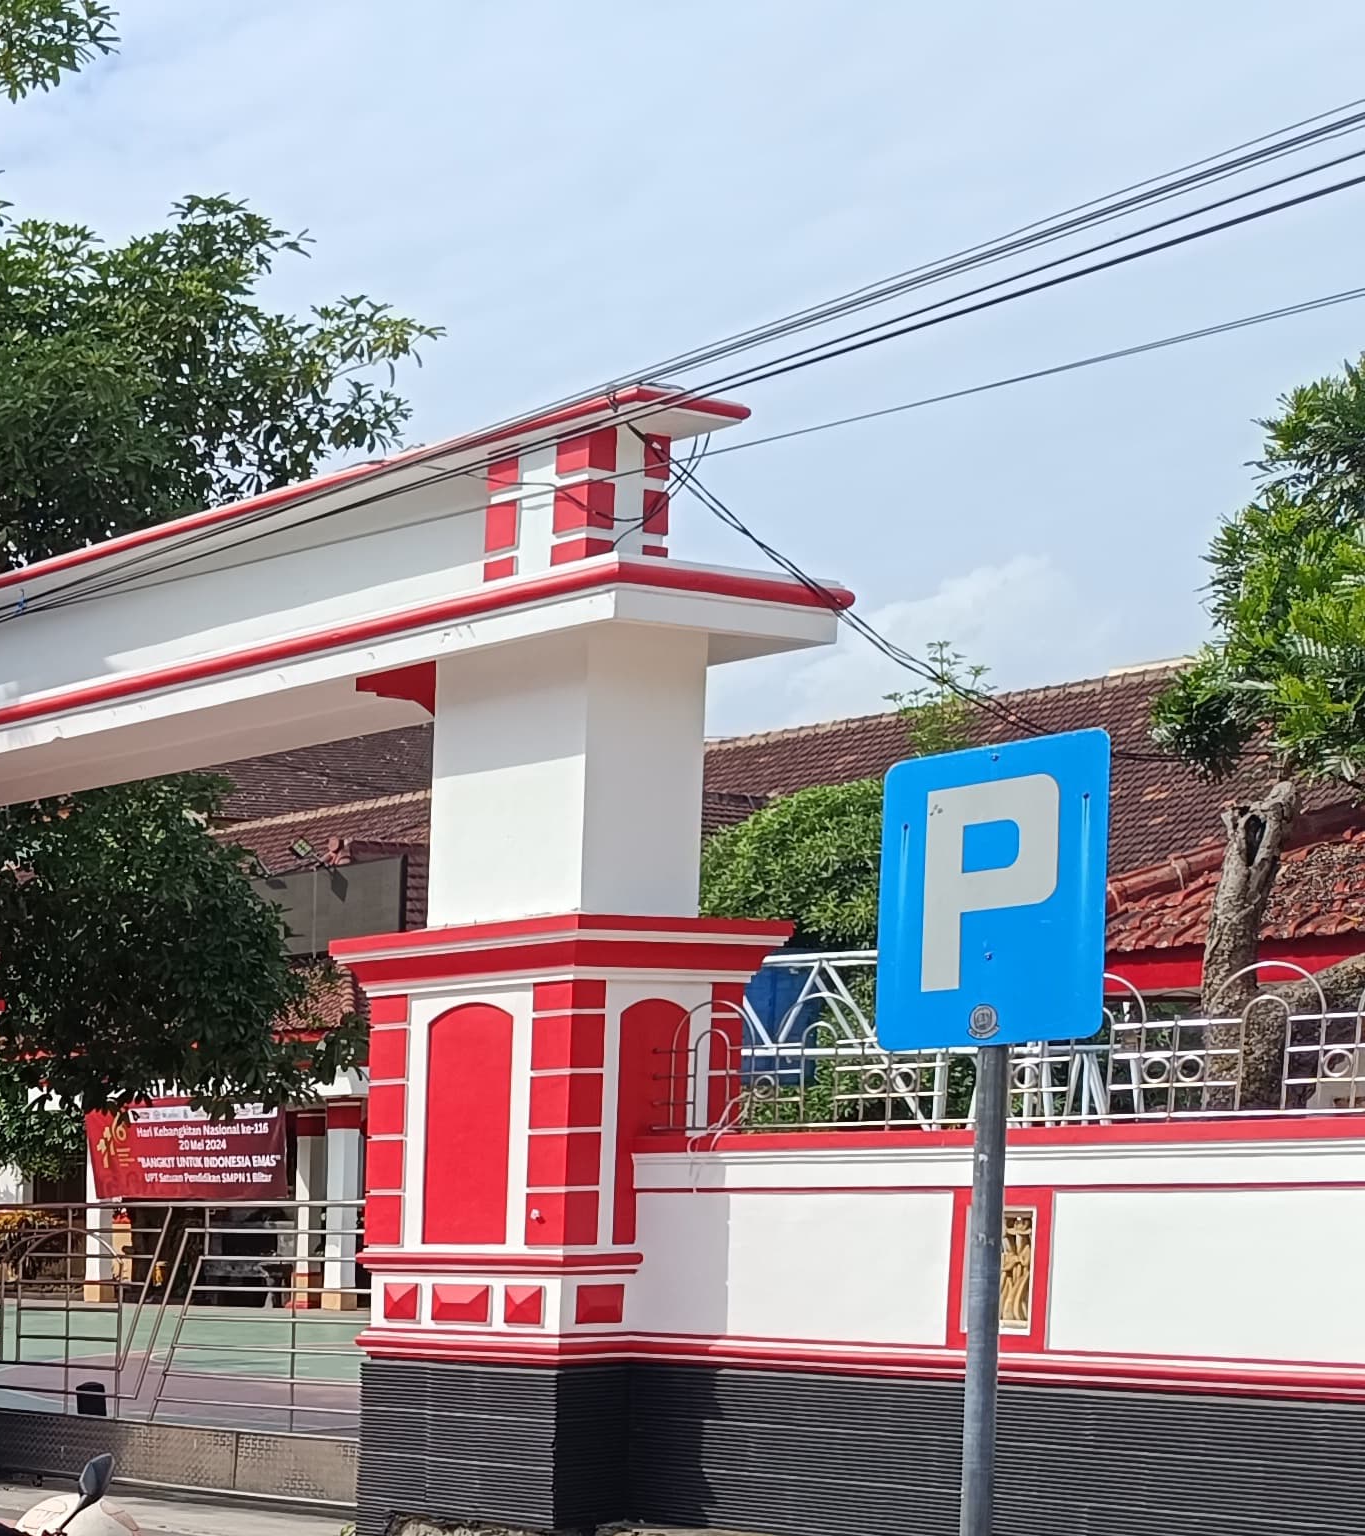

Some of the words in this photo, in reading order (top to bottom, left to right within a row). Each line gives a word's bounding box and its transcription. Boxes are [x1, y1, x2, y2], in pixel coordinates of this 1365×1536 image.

[921, 774, 1059, 993] P
[137, 1127, 152, 1138] Hari
[154, 1126, 201, 1138] Kebangkitan
[203, 1124, 240, 1136] Nasional
[241, 1123, 269, 1135] ke-116
[178, 1140, 189, 1150] 20
[191, 1140, 204, 1150] Mei
[205, 1138, 227, 1150] 2024
[177, 1155, 203, 1168] UNTUK
[204, 1155, 251, 1168] INDONESIA
[222, 1172, 245, 1183] SMPN
